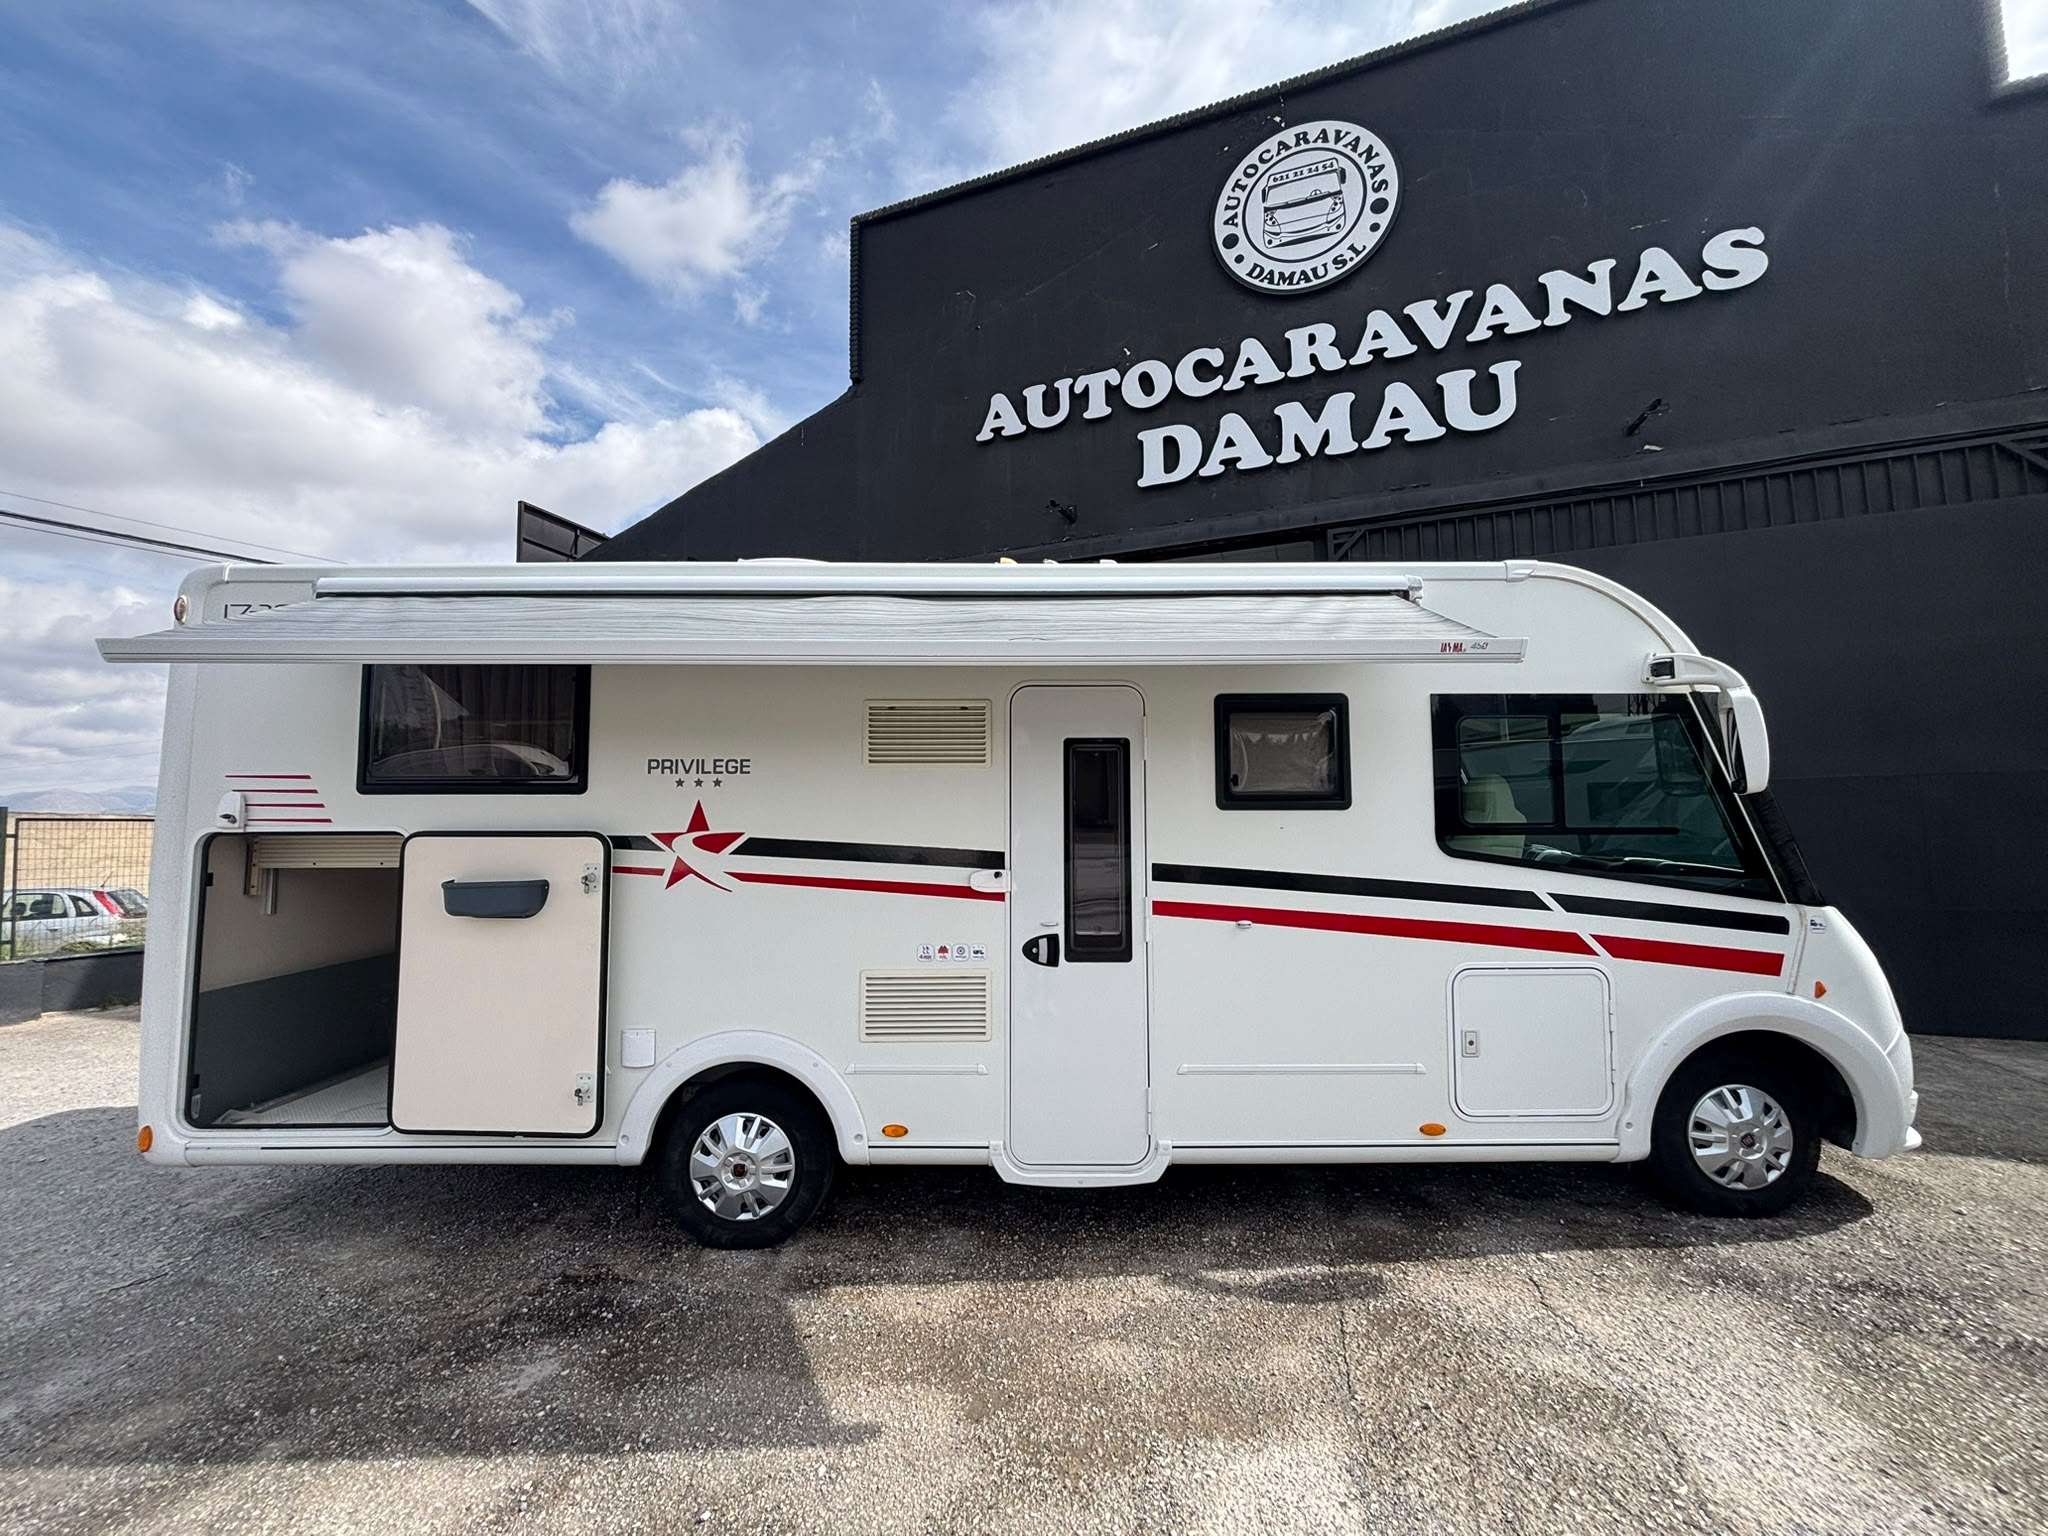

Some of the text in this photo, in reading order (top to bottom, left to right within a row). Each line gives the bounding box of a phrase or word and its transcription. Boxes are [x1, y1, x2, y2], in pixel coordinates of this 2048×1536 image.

[1222, 128, 1389, 228] AUTOCARAVANAS
[1272, 161, 1334, 183] 621 21 24 54
[1246, 262, 1329, 286] DAMAU
[976, 227, 1768, 441] AUTOCARAVANAS
[1137, 361, 1521, 487] DAMAU
[647, 758, 751, 775] PRIVILEGE
